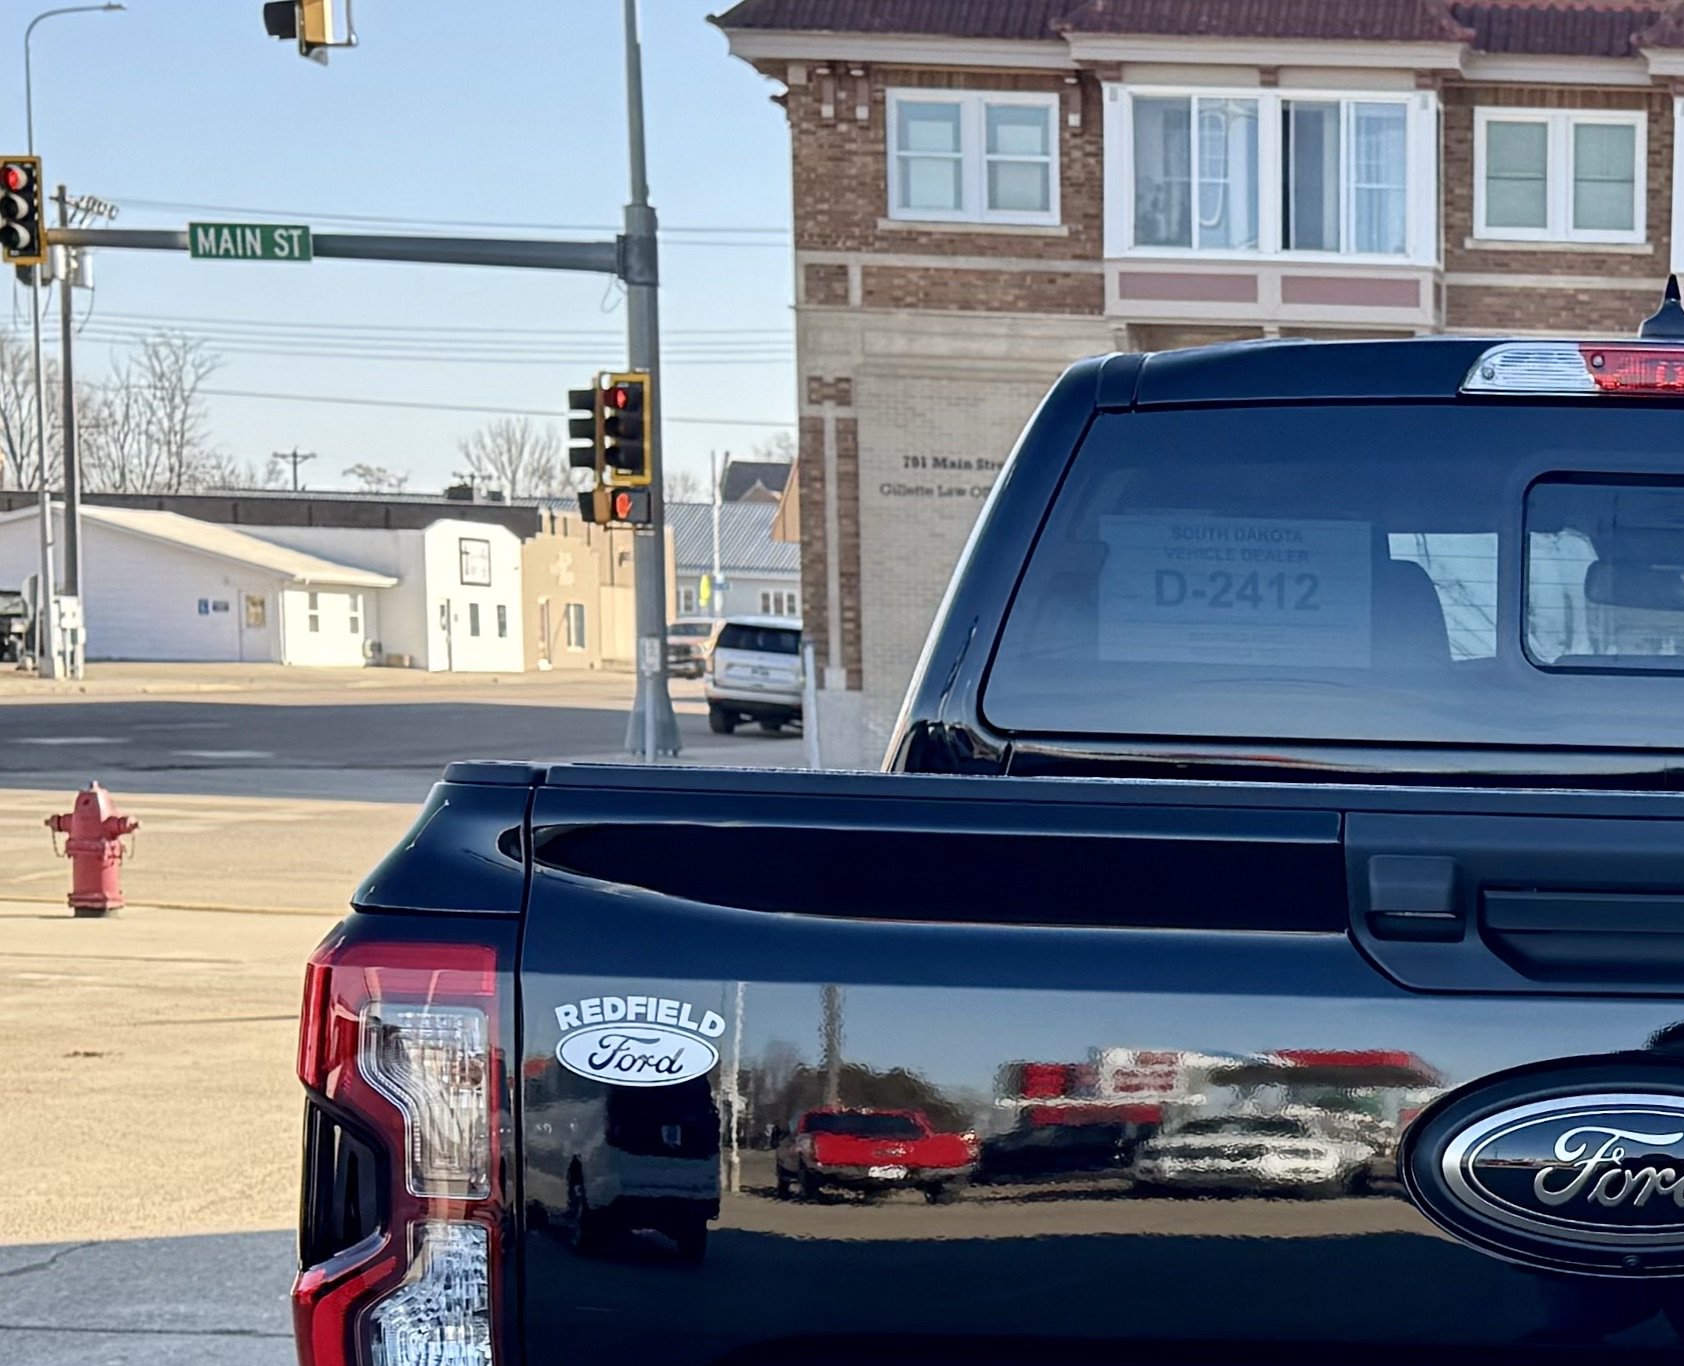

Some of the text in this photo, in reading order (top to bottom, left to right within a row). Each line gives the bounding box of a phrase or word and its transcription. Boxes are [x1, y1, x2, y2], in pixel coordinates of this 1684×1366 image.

[197, 226, 302, 257] MAIN ST
[932, 457, 972, 470] Main
[976, 459, 1004, 471] Stre
[938, 485, 966, 498] Law
[1171, 526, 1303, 543] SOUTH DAKOTA
[1164, 546, 1309, 563] VEHICLE DEALER
[1156, 569, 1320, 610] D-2412
[554, 996, 726, 1038] REDFIELD
[588, 1034, 684, 1075] Ford
